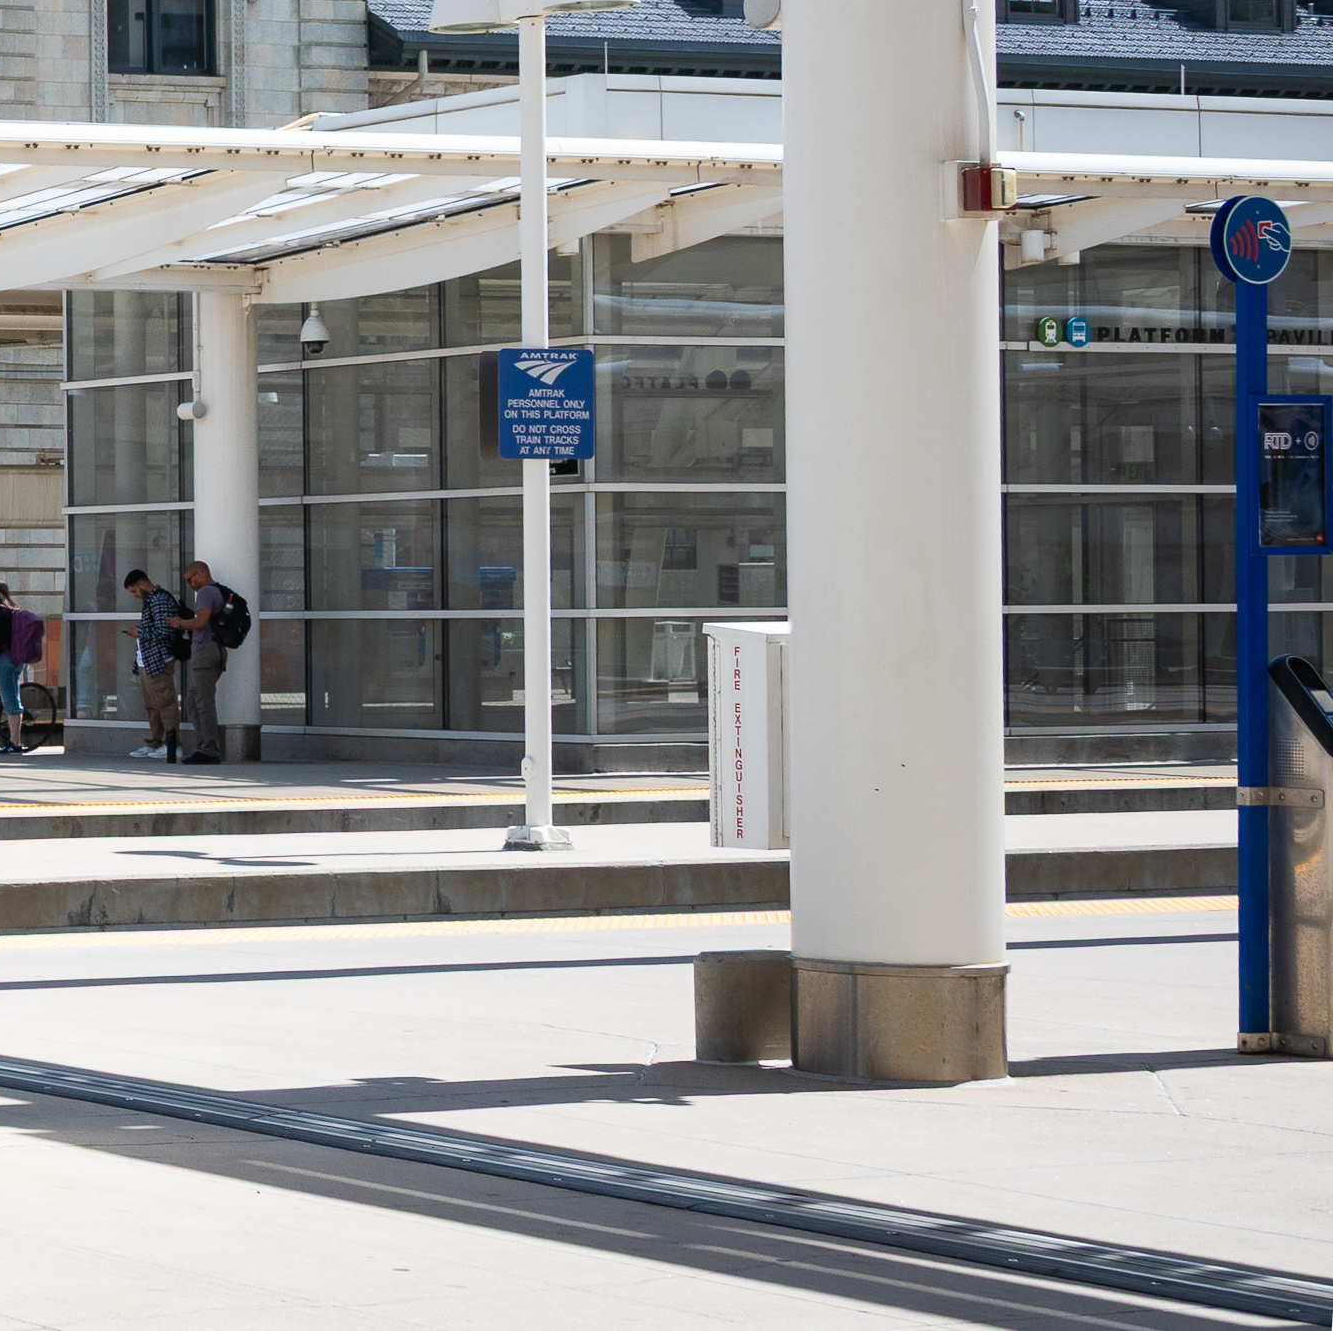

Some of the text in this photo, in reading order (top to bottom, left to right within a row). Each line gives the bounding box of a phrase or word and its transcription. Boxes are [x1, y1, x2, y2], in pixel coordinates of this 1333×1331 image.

[1097, 326, 1226, 343] PLATFORM
[520, 352, 577, 360] AMTRAK
[528, 389, 565, 398] AMTRAK
[507, 399, 585, 409] PERSONNEL ONLY
[504, 410, 590, 420] ON THIS PLATFORM
[512, 425, 581, 434] DO NOT CROSS
[515, 435, 579, 445] TRAIN TRACKS
[1264, 432, 1292, 450] RTD
[519, 446, 574, 455] AT ANY TIME
[733, 646, 741, 690] FIRE
[734, 703, 744, 839] EXTINGUISHER
